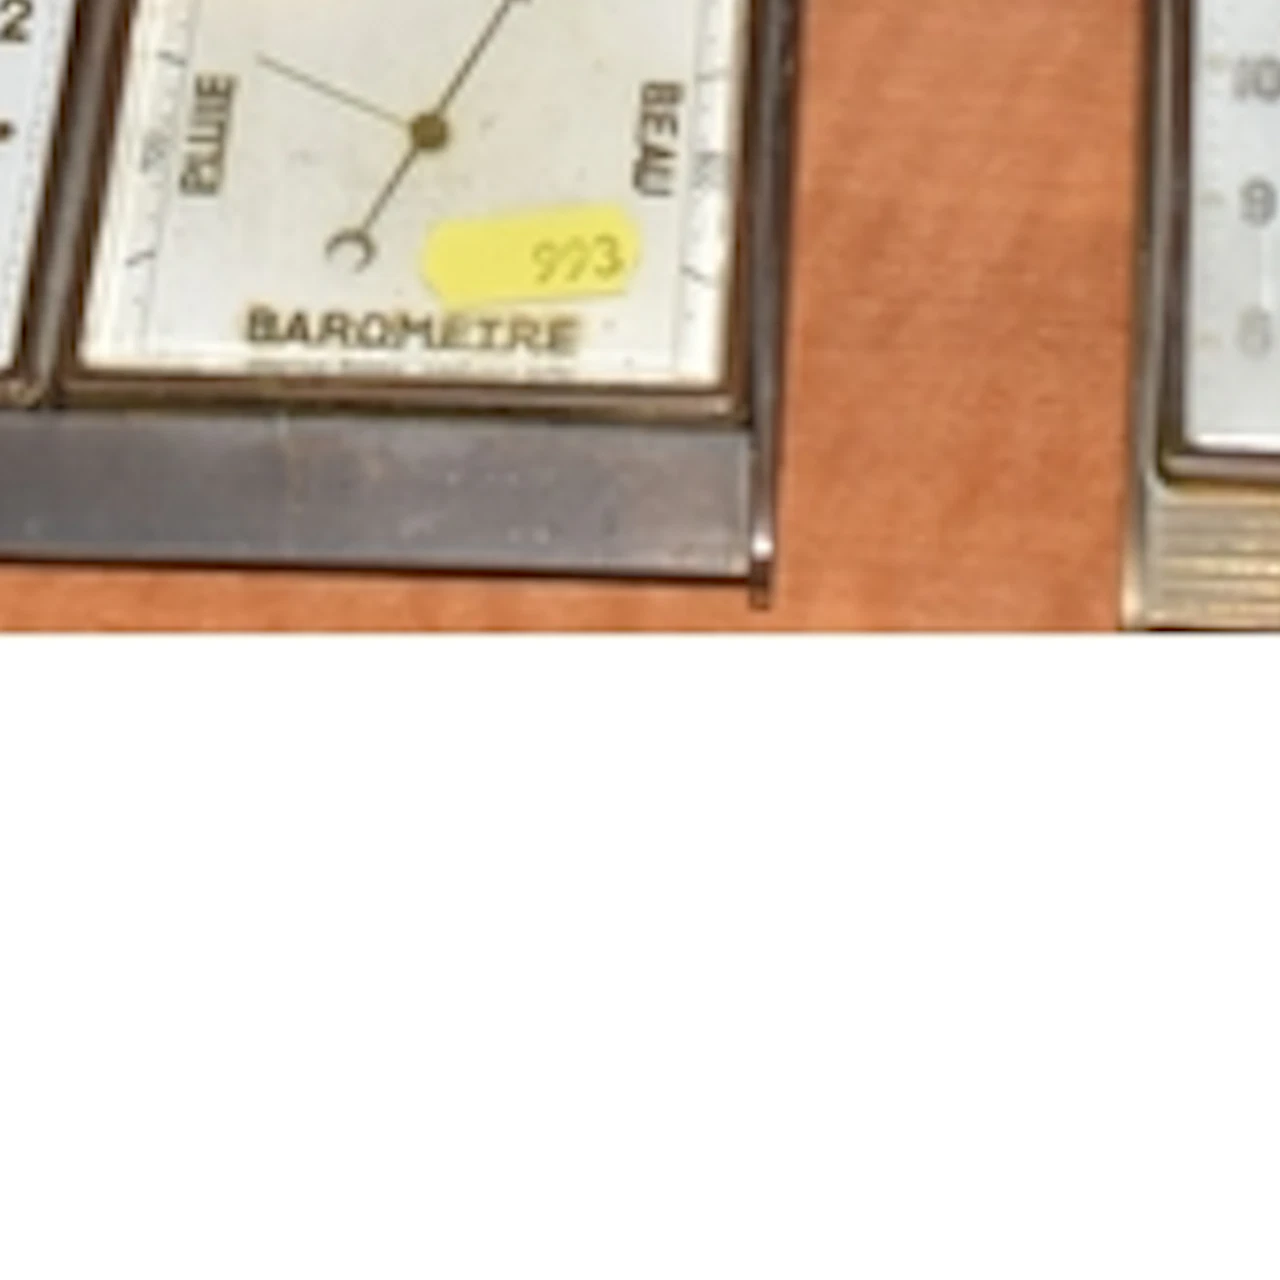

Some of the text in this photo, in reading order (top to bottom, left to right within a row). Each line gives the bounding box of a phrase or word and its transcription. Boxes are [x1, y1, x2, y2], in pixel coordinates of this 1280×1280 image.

[179, 72, 239, 197] PLUIE
[630, 80, 685, 198] BEAU
[1239, 176, 1278, 227] 9
[530, 231, 626, 285] 993
[244, 302, 584, 355] BAROMETRE
